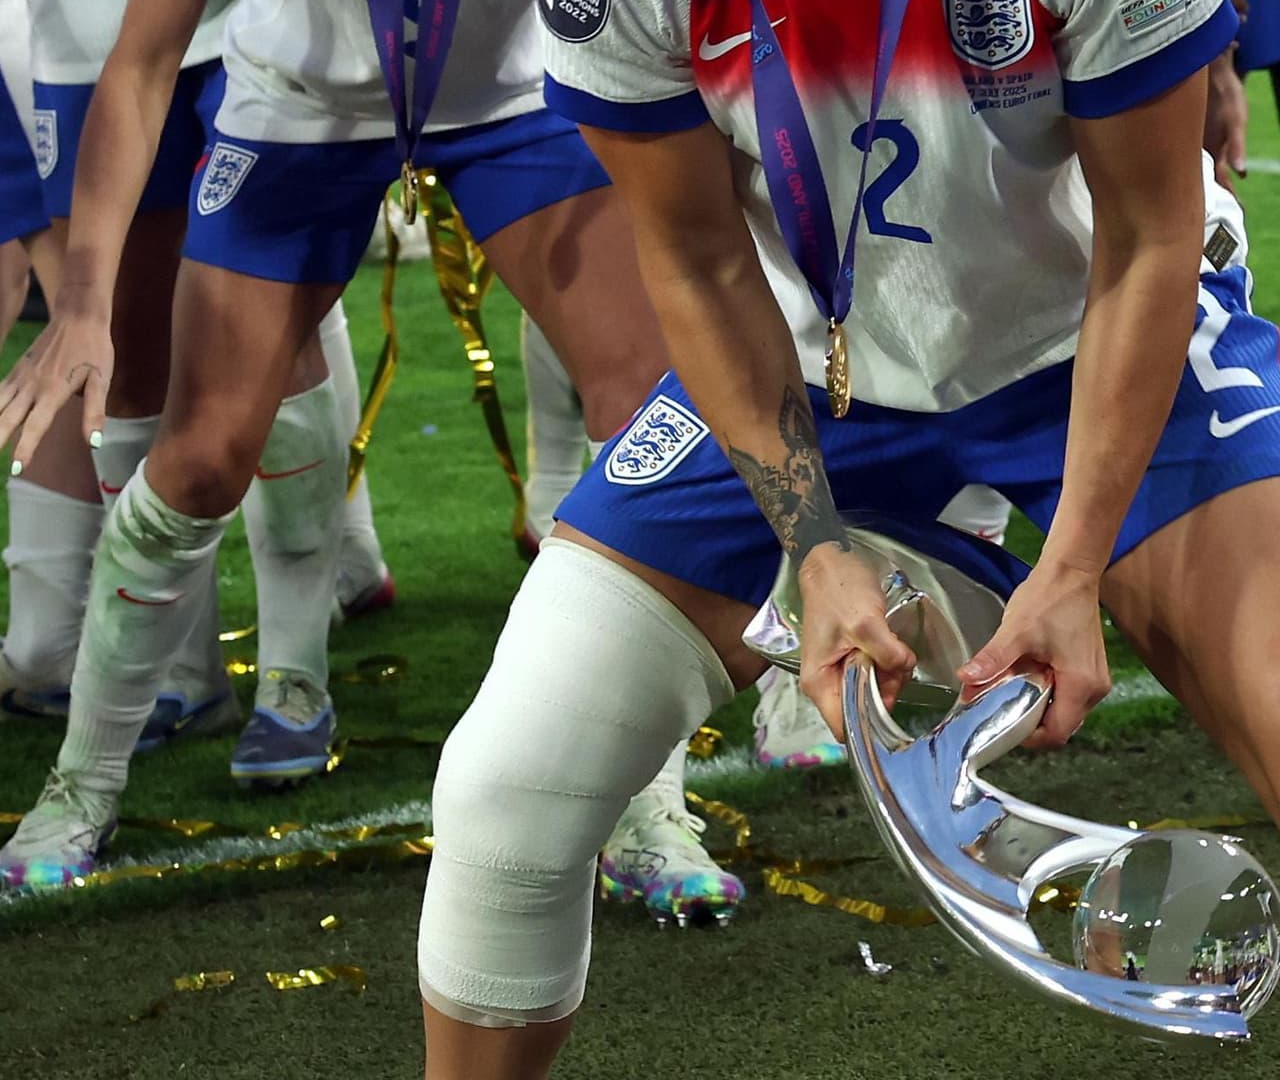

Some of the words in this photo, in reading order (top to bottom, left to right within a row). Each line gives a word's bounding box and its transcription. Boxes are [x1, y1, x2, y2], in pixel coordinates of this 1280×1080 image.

[1121, 0, 1145, 16] UEFA
[1002, 84, 1028, 97] 2025
[774, 127, 798, 169] 2025
[851, 118, 933, 244] 2
[1188, 281, 1265, 394] 2
